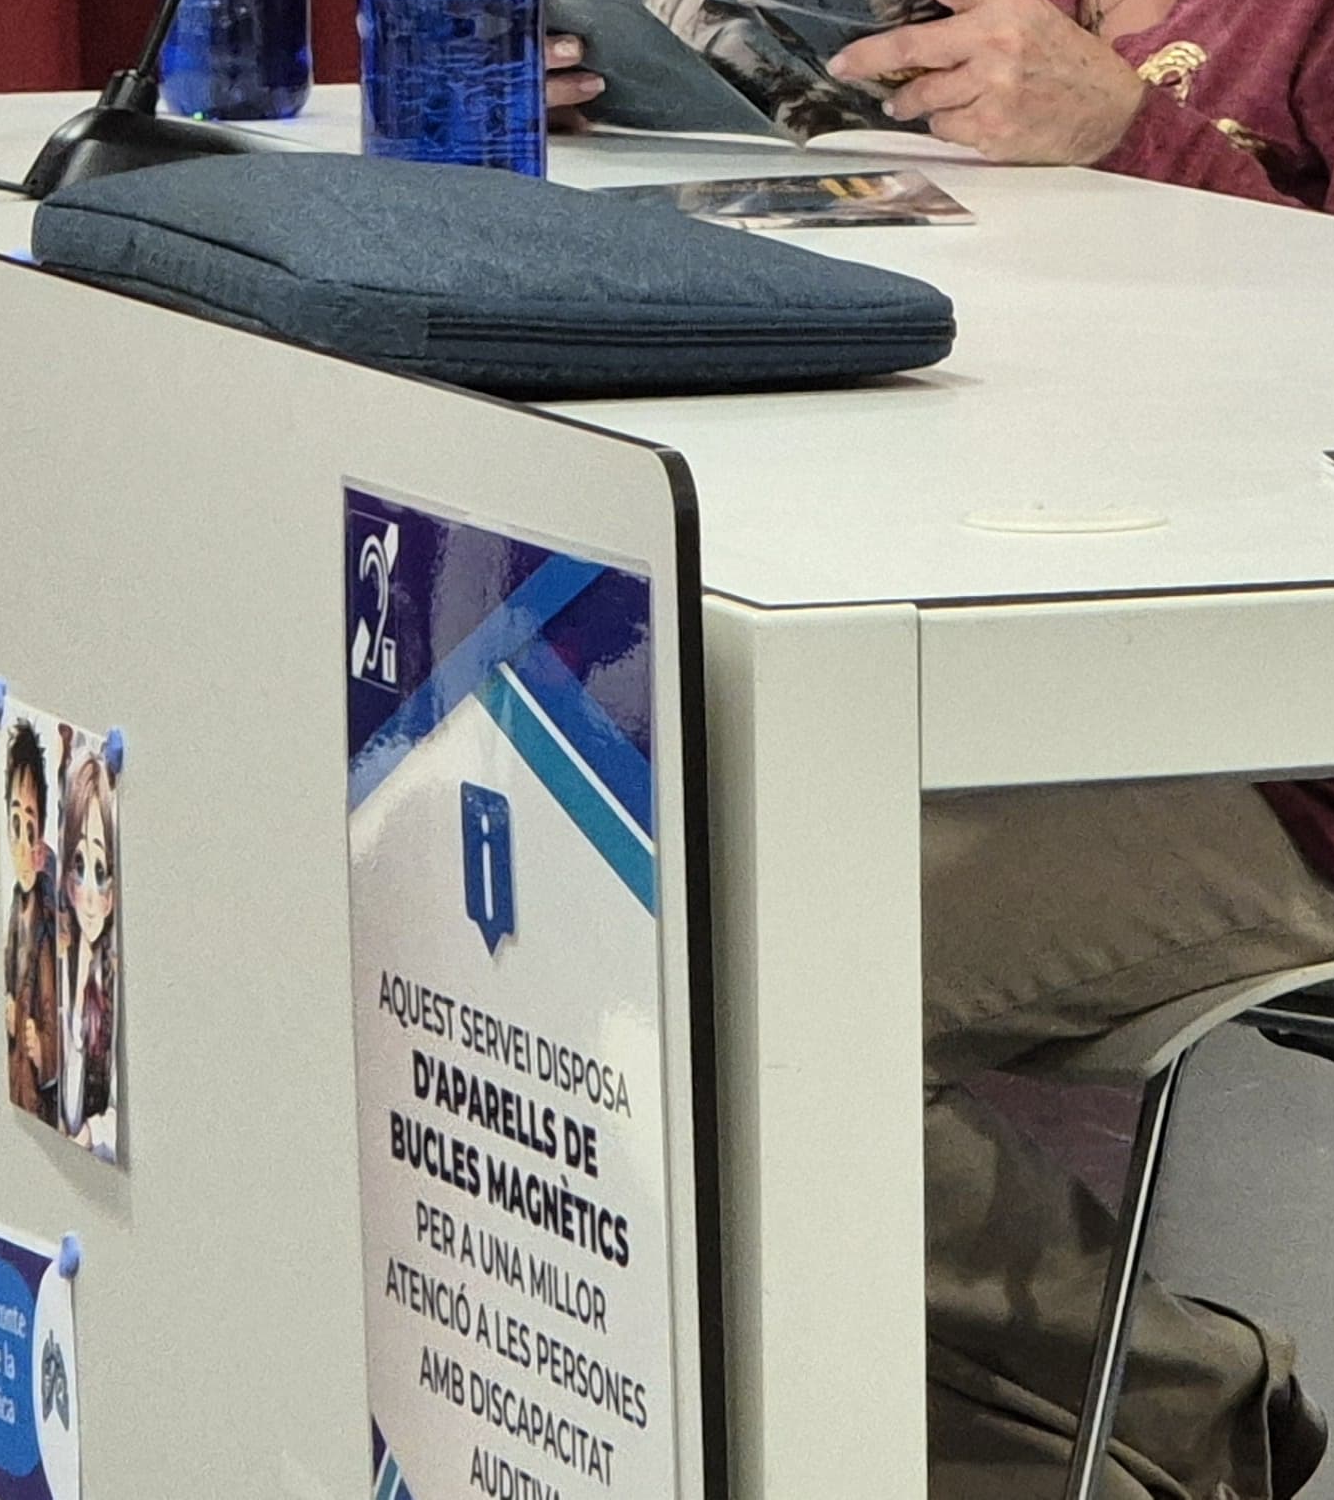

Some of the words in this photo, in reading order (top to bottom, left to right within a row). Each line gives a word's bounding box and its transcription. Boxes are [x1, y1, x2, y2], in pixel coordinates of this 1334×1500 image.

[379, 970, 455, 1041] AQUEST
[461, 1004, 531, 1074] SERVEI
[536, 1036, 631, 1118] DISPOSA
[413, 1049, 555, 1159] D'APARELLS
[564, 1116, 599, 1178] DE
[390, 1110, 480, 1198] BUCLES
[487, 1154, 630, 1268] MAGNÈTICS
[416, 1200, 455, 1258] PER
[461, 1223, 474, 1268] A
[480, 1231, 524, 1292] UNA
[528, 1253, 607, 1334] MILLOR
[4, 1341, 15, 1379] la
[385, 1258, 470, 1337] ATENCIÓ
[475, 1304, 491, 1350] A
[495, 1309, 530, 1370] LES
[536, 1331, 648, 1430] PERSONES
[420, 1345, 464, 1406] AMB
[470, 1371, 614, 1487] DISCAPACITAT
